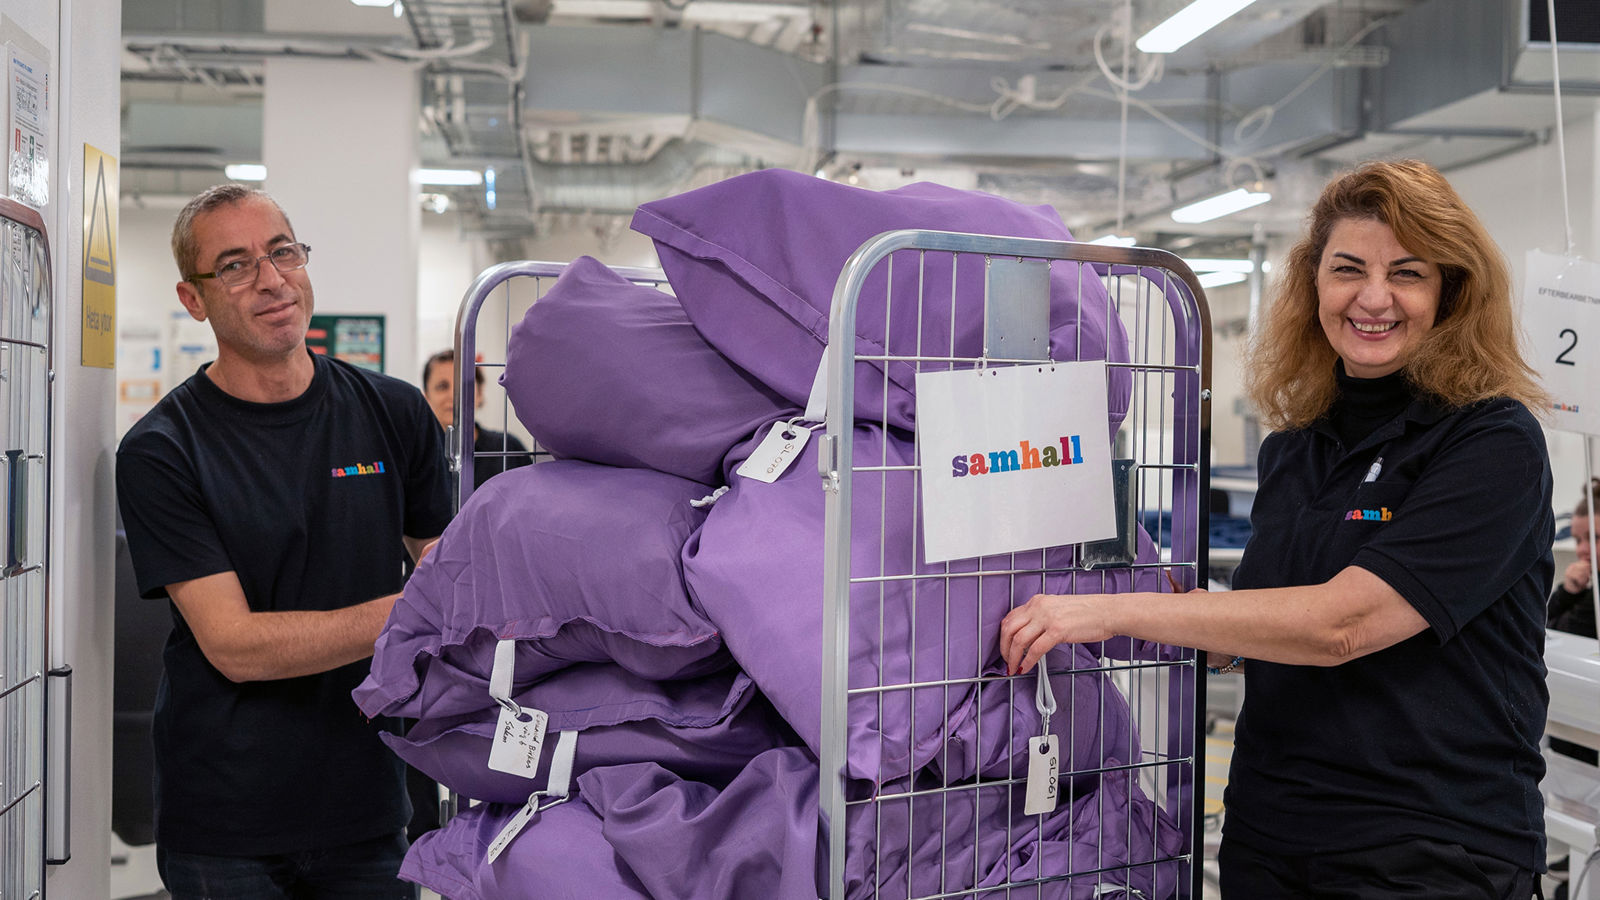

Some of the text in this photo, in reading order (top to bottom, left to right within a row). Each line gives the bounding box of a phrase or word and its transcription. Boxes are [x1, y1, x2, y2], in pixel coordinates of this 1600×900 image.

[86, 304, 99, 331] Heta
[1555, 328, 1578, 367] 2
[331, 461, 386, 478] samhall
[952, 435, 1084, 478] samhall
[1047, 757, 1057, 800] SL061
